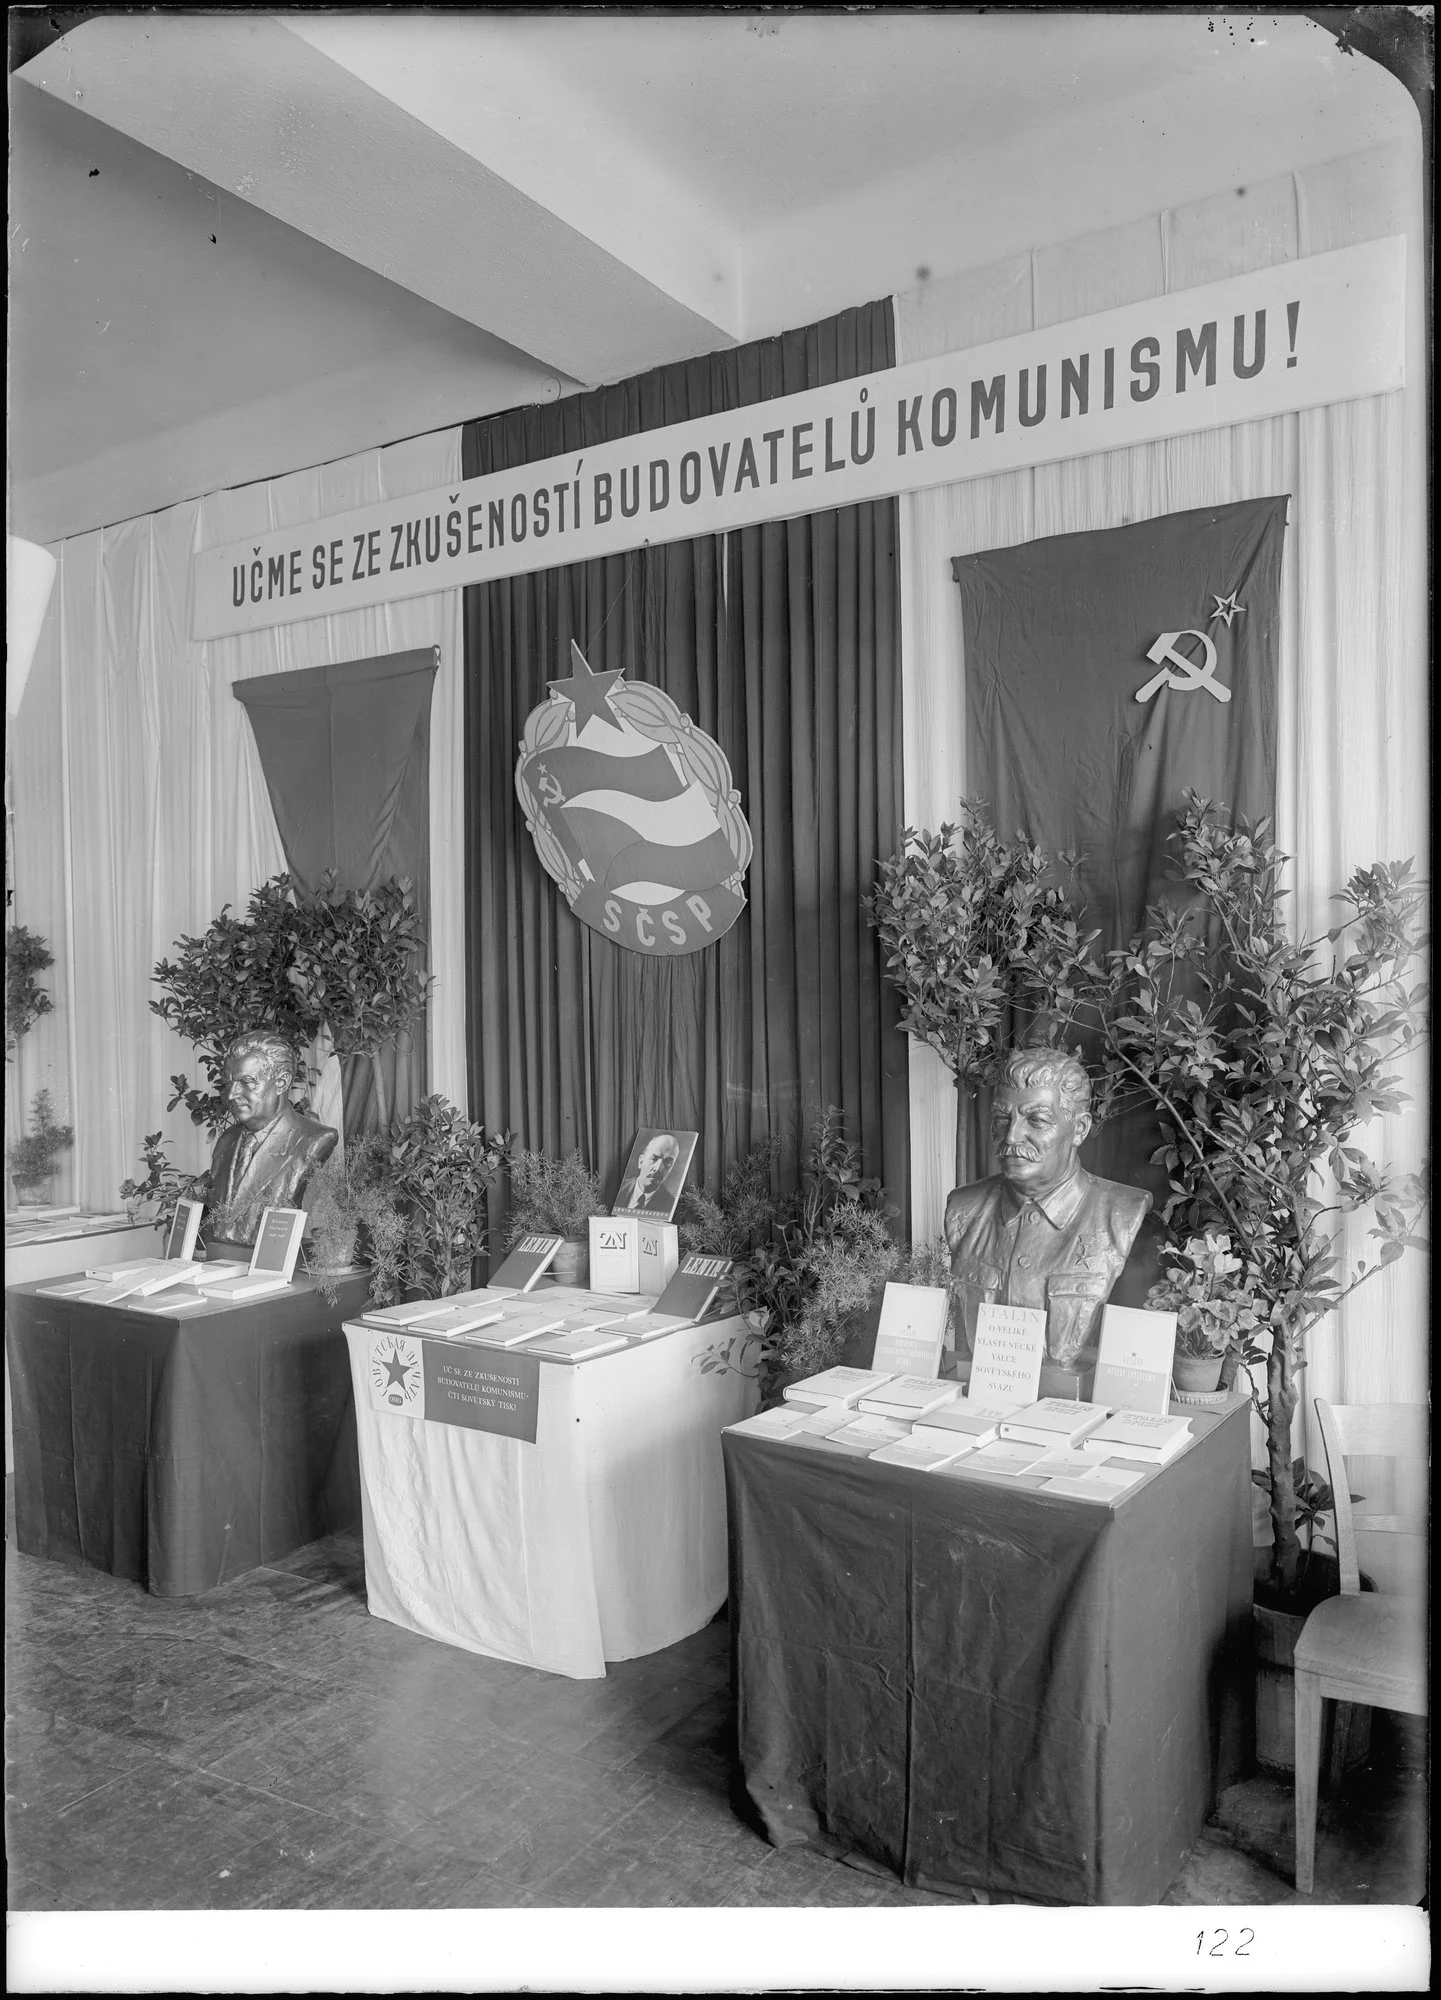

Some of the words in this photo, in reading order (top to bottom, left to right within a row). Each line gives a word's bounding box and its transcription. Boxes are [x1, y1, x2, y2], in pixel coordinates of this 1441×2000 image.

[232, 546, 303, 607] UČME
[311, 539, 344, 589] SE
[351, 530, 382, 581] ZE
[388, 459, 582, 571] ZKUŠENOSTÍ
[594, 386, 876, 525] BUDOVATELŮ
[897, 300, 1300, 456] KOMUNISMU!
[602, 894, 719, 948] SČSP
[517, 1236, 557, 1254] LENIN
[979, 1305, 1041, 1323] STALIN
[454, 1367, 461, 1376] SE
[463, 1369, 473, 1378] ZE
[987, 1382, 1015, 1393] SVAZU
[498, 1400, 517, 1411] TISK!
[1045, 1400, 1095, 1413] STALIN
[1123, 1413, 1175, 1424] STALIN
[1196, 1927, 1255, 1957] 122
